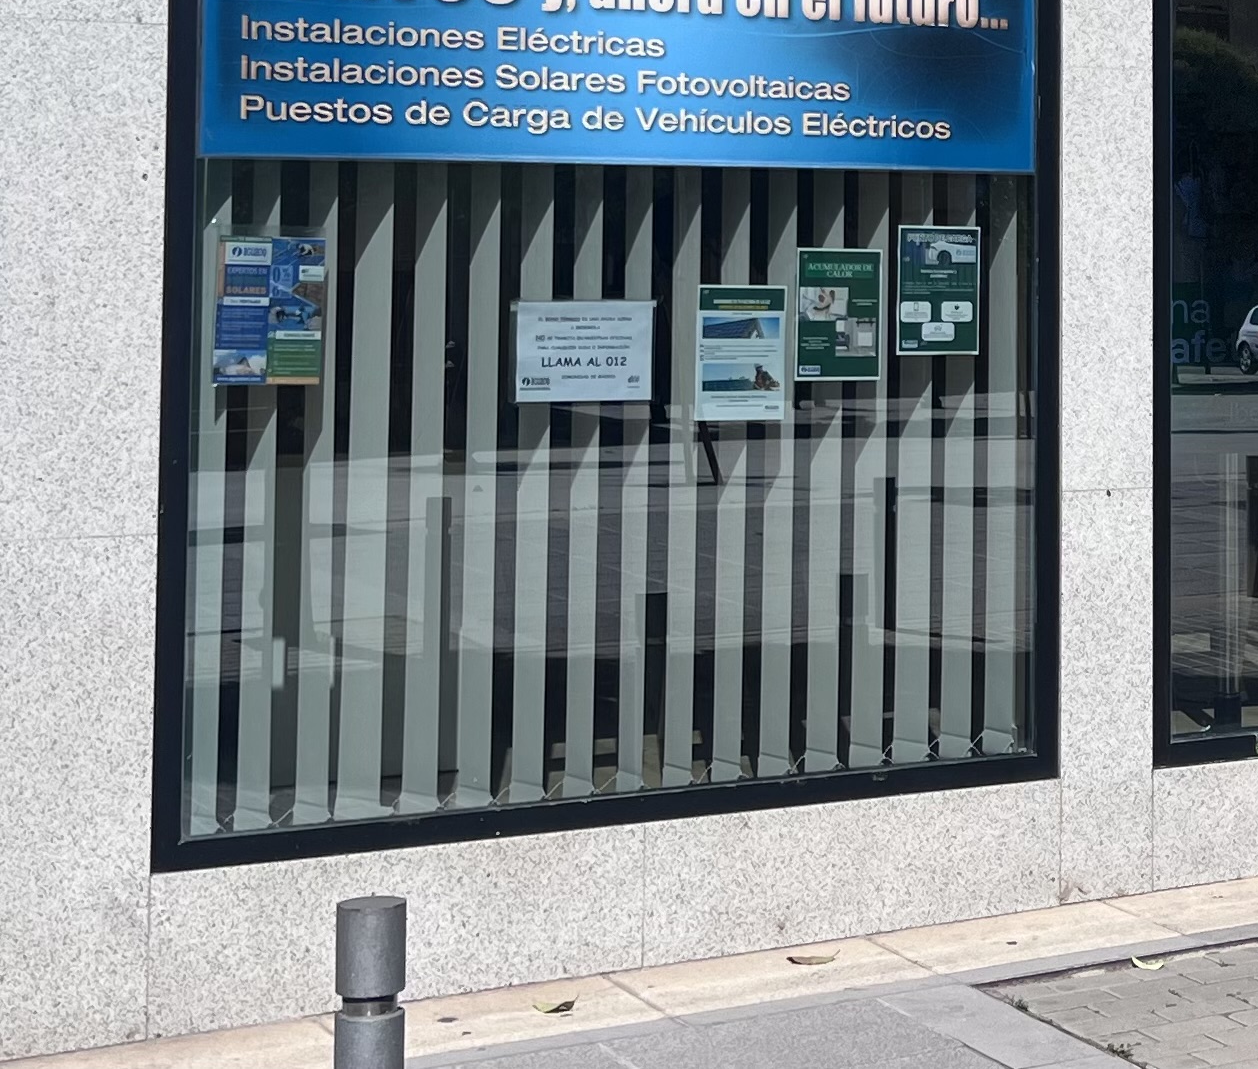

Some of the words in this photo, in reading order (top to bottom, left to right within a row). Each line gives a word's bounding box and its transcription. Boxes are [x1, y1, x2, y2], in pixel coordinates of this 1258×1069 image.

[241, 14, 484, 50] Instalaciones
[497, 26, 665, 58] Eléctricas
[241, 55, 484, 89] Instalaciones
[496, 66, 625, 94] Solares
[638, 70, 851, 102] Fotovoltaicas
[240, 95, 393, 125] Puestos
[404, 100, 450, 127] de
[462, 102, 571, 136] Carga
[582, 105, 624, 132] de
[635, 106, 791, 135] Vehículos
[802, 112, 951, 141] Eléctricos
[541, 356, 582, 368] LLAMA
[587, 356, 602, 368] AL
[606, 356, 628, 367] 012
